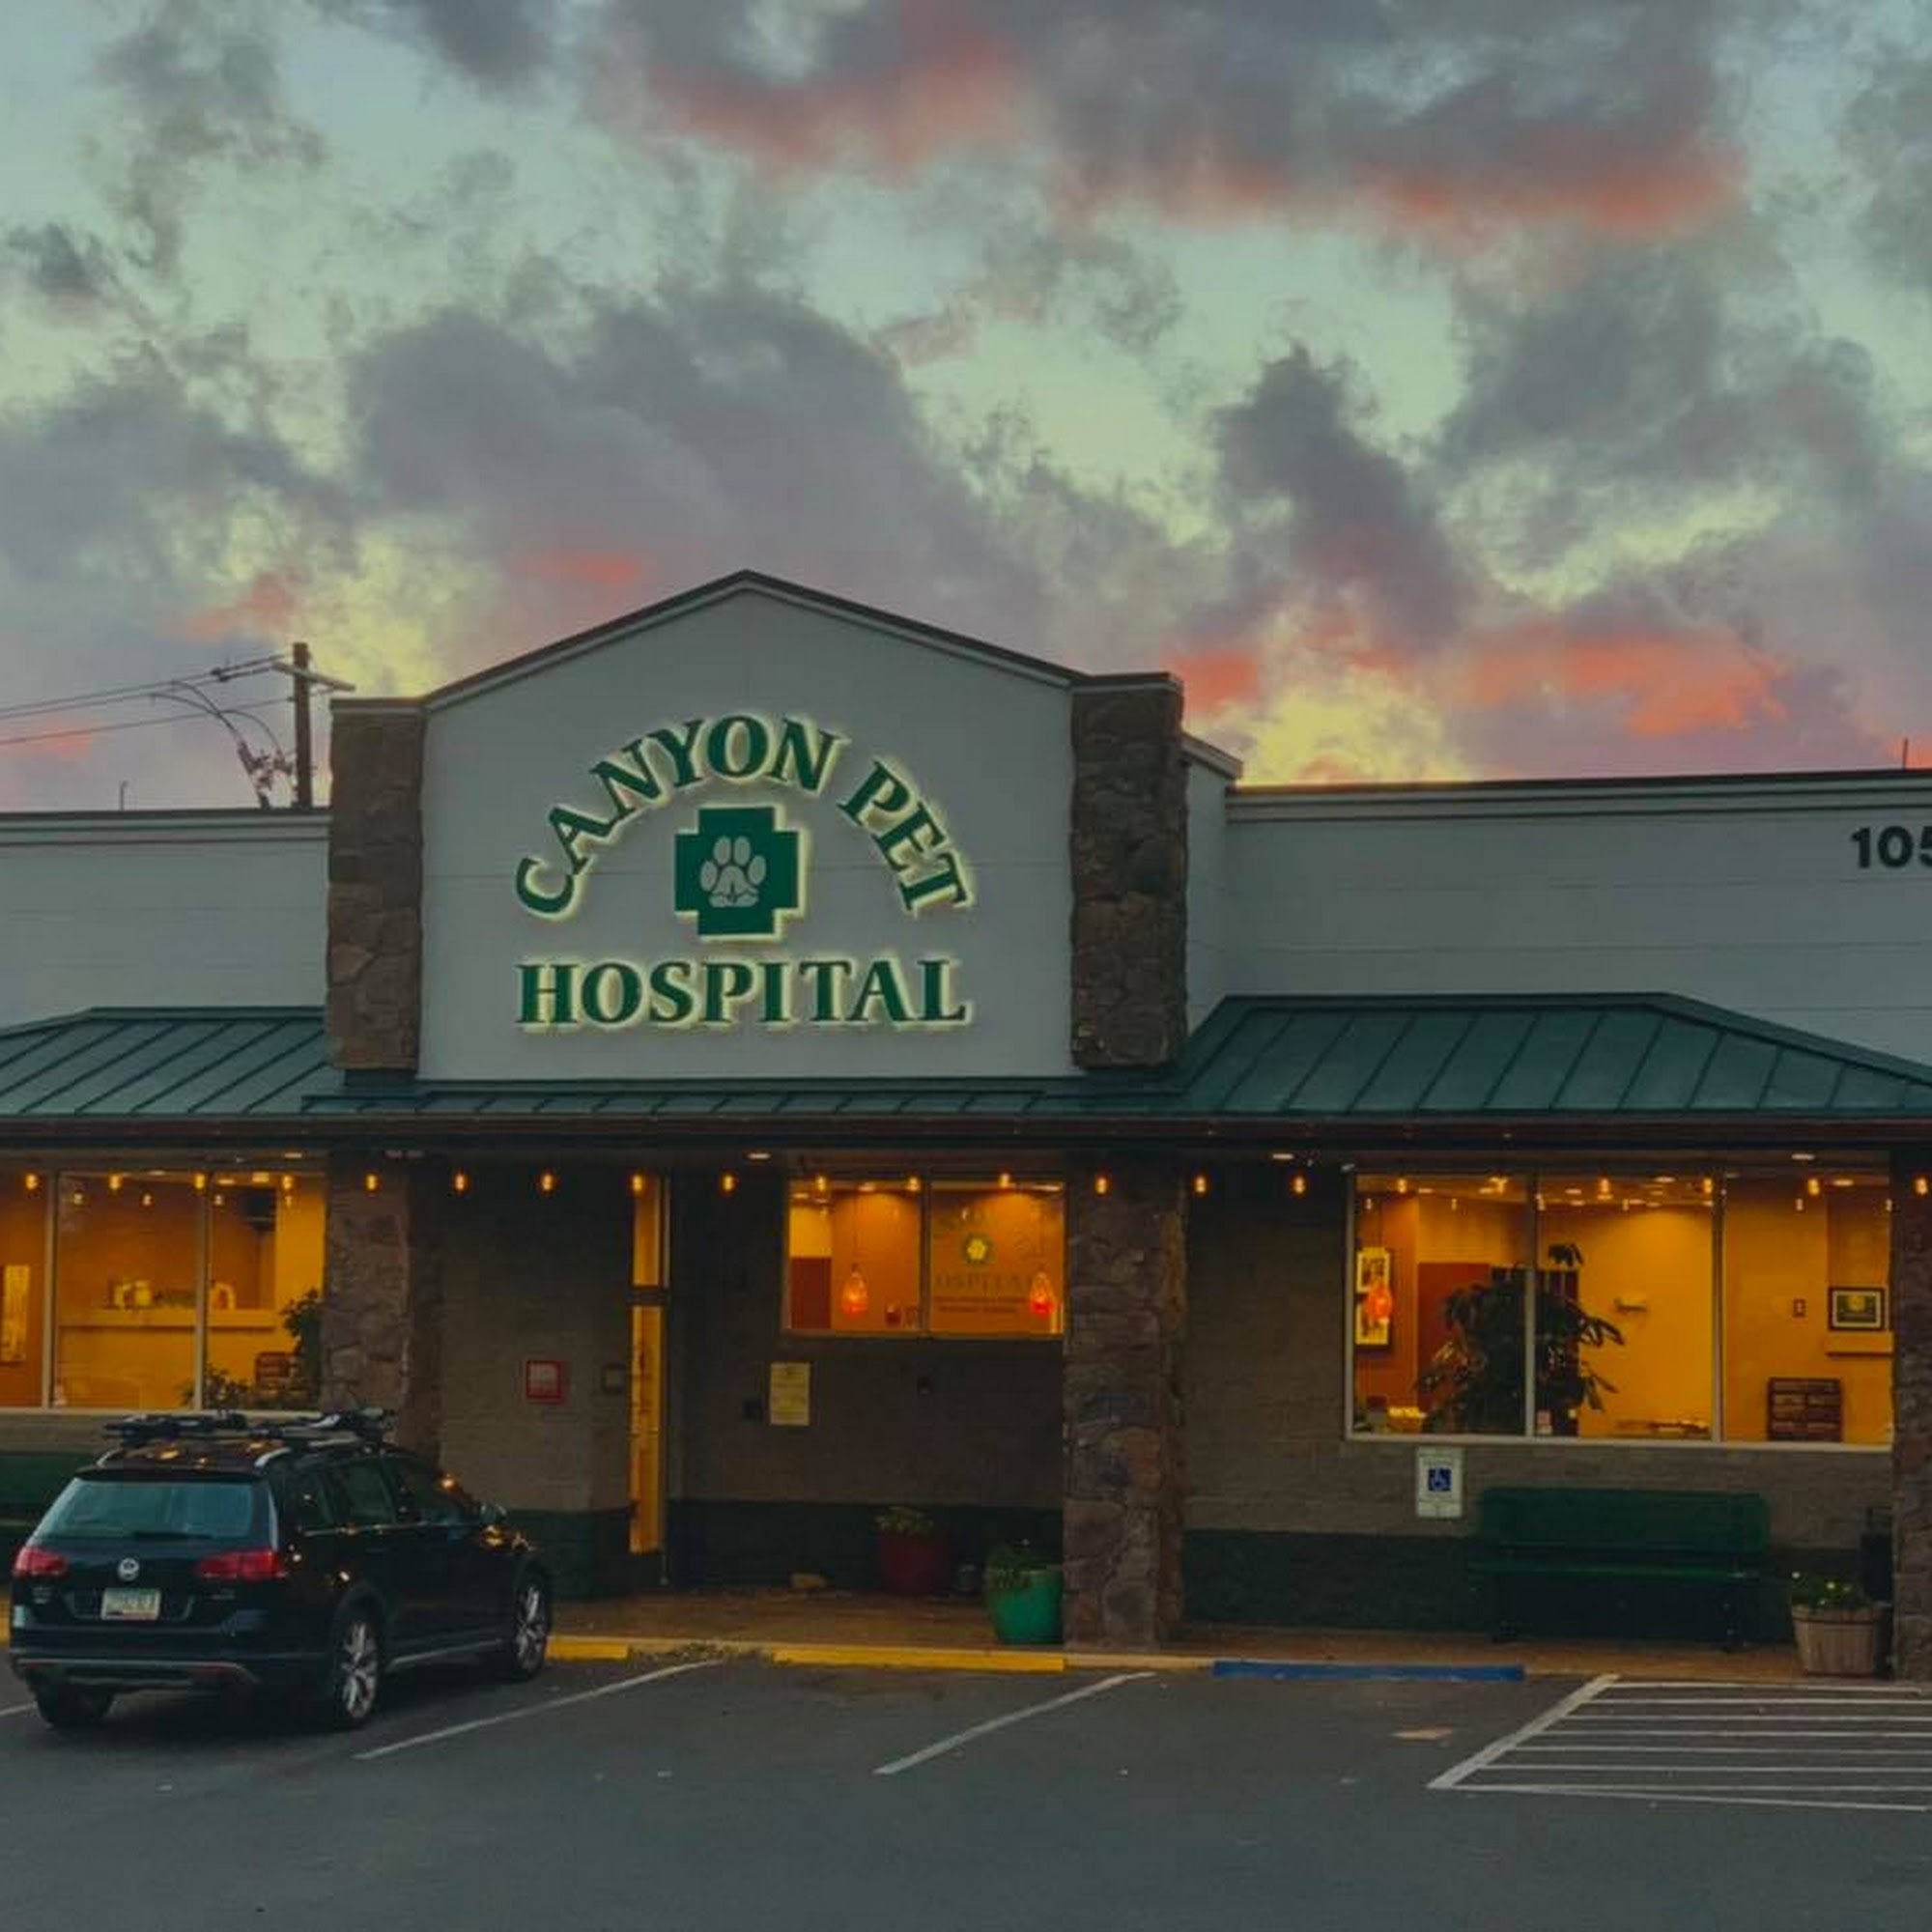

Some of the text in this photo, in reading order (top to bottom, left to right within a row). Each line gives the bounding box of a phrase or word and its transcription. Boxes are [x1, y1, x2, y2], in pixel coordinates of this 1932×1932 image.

[515, 715, 970, 915] CANYON PET
[515, 958, 970, 1025] HOSPITAL
